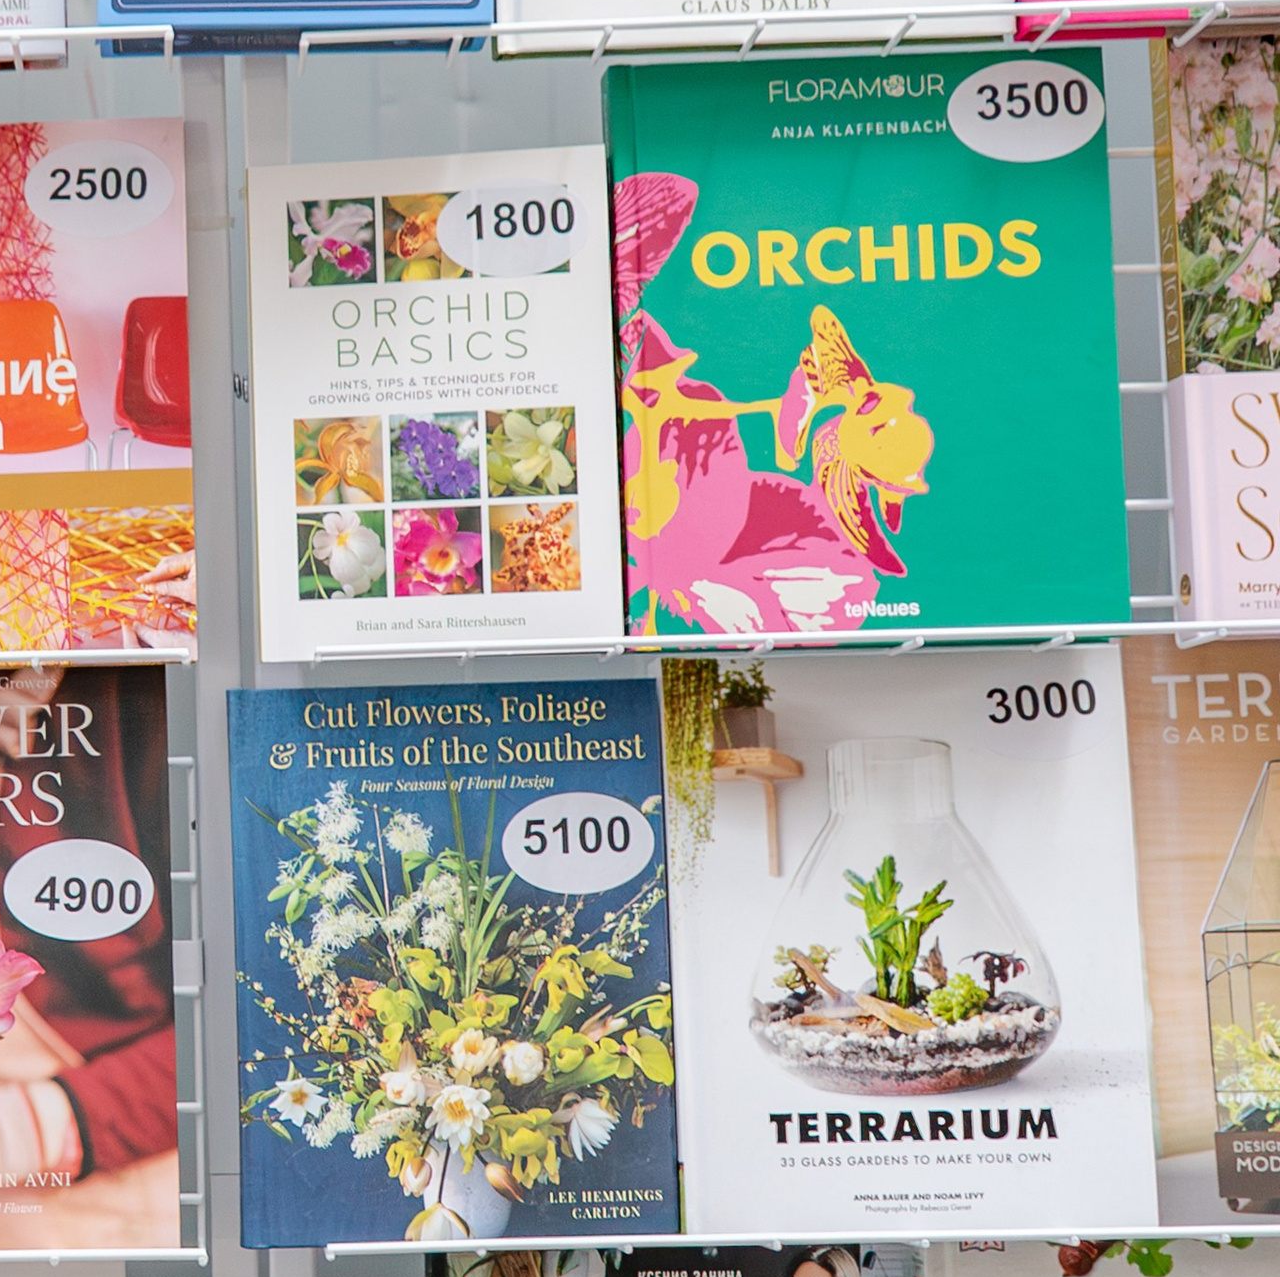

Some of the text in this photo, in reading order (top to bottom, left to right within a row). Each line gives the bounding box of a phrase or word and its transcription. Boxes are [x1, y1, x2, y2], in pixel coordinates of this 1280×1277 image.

[977, 80, 1088, 120] 3500
[772, 120, 946, 139] ANJA KLAFFENBACH
[50, 168, 148, 201] 2500
[465, 198, 574, 240] 1800
[690, 219, 1042, 289] ORCHIDS
[333, 292, 530, 328] ORCHID
[336, 328, 530, 368] BASICS
[845, 600, 920, 618] teNeues
[303, 694, 607, 730] Cut Flowers, Foliage
[986, 680, 1096, 723] 3000
[270, 732, 646, 769] & Fruits of the Southeast
[522, 817, 631, 856] 5100
[34, 876, 142, 915] 4900
[770, 1109, 1058, 1144] TERRARIUM
[781, 1151, 1051, 1168] 33 GLASS GARDENS TO MAKE YOUR OWN
